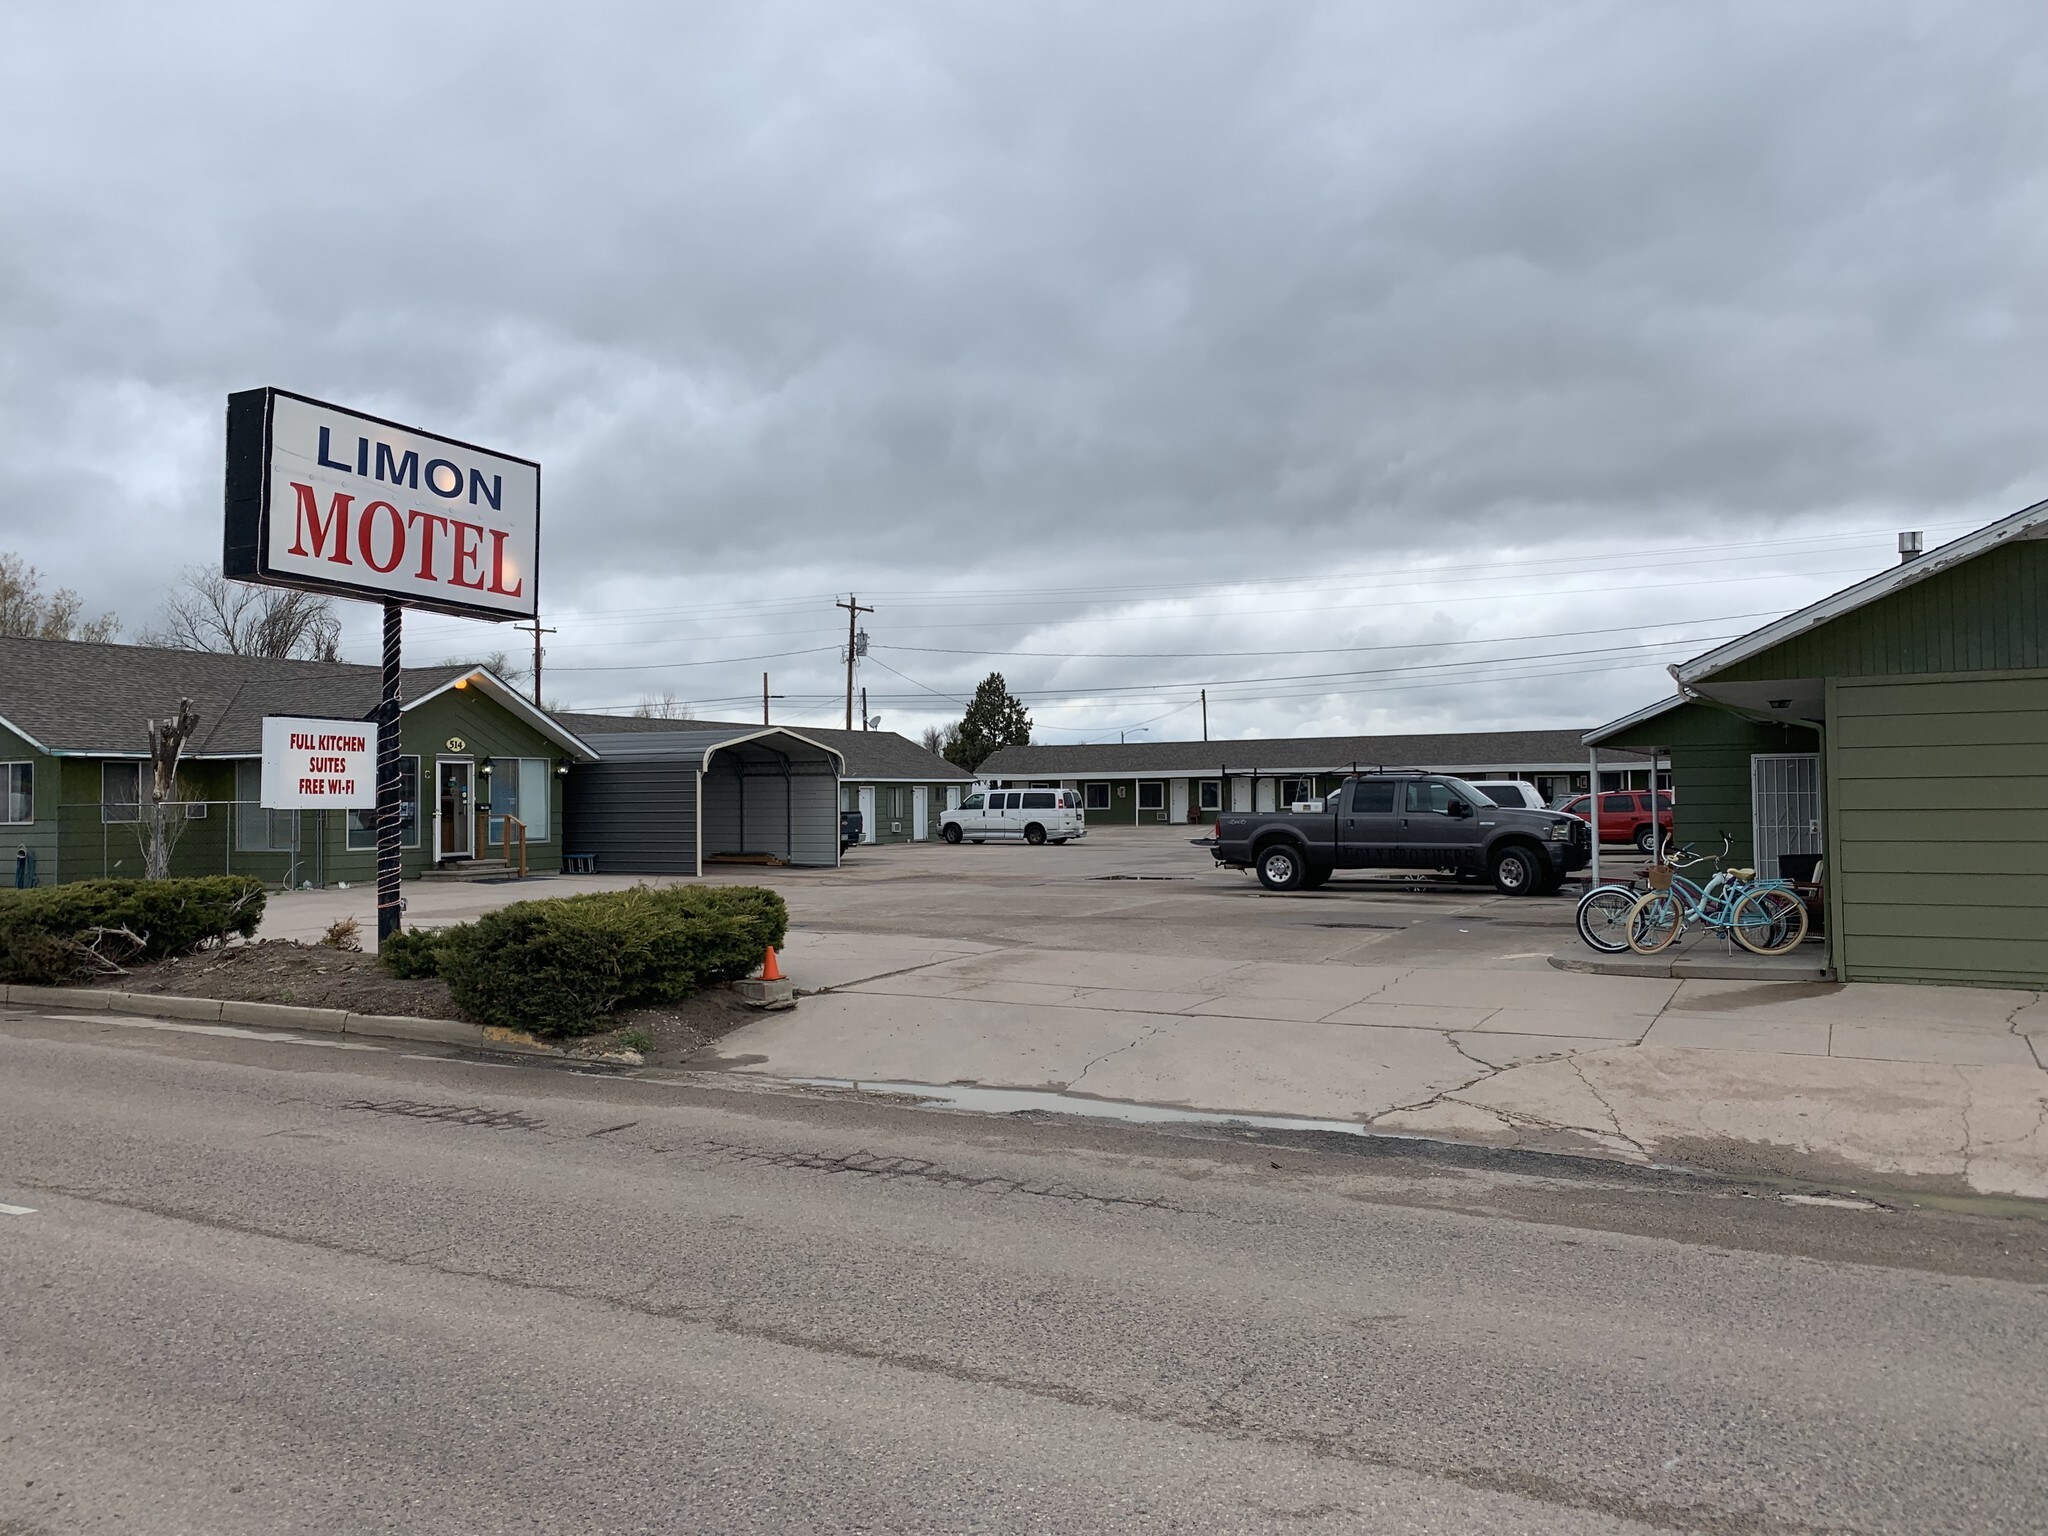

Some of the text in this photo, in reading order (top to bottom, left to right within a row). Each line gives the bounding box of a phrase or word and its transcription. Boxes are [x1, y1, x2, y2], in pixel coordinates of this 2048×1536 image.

[317, 426, 502, 511] LIMON
[287, 481, 522, 598] MOTEL
[290, 733, 365, 752] FULL KITCHEN
[449, 740, 462, 749] 514
[309, 756, 346, 773] SUITES
[299, 778, 354, 794] FREE WI-FI
